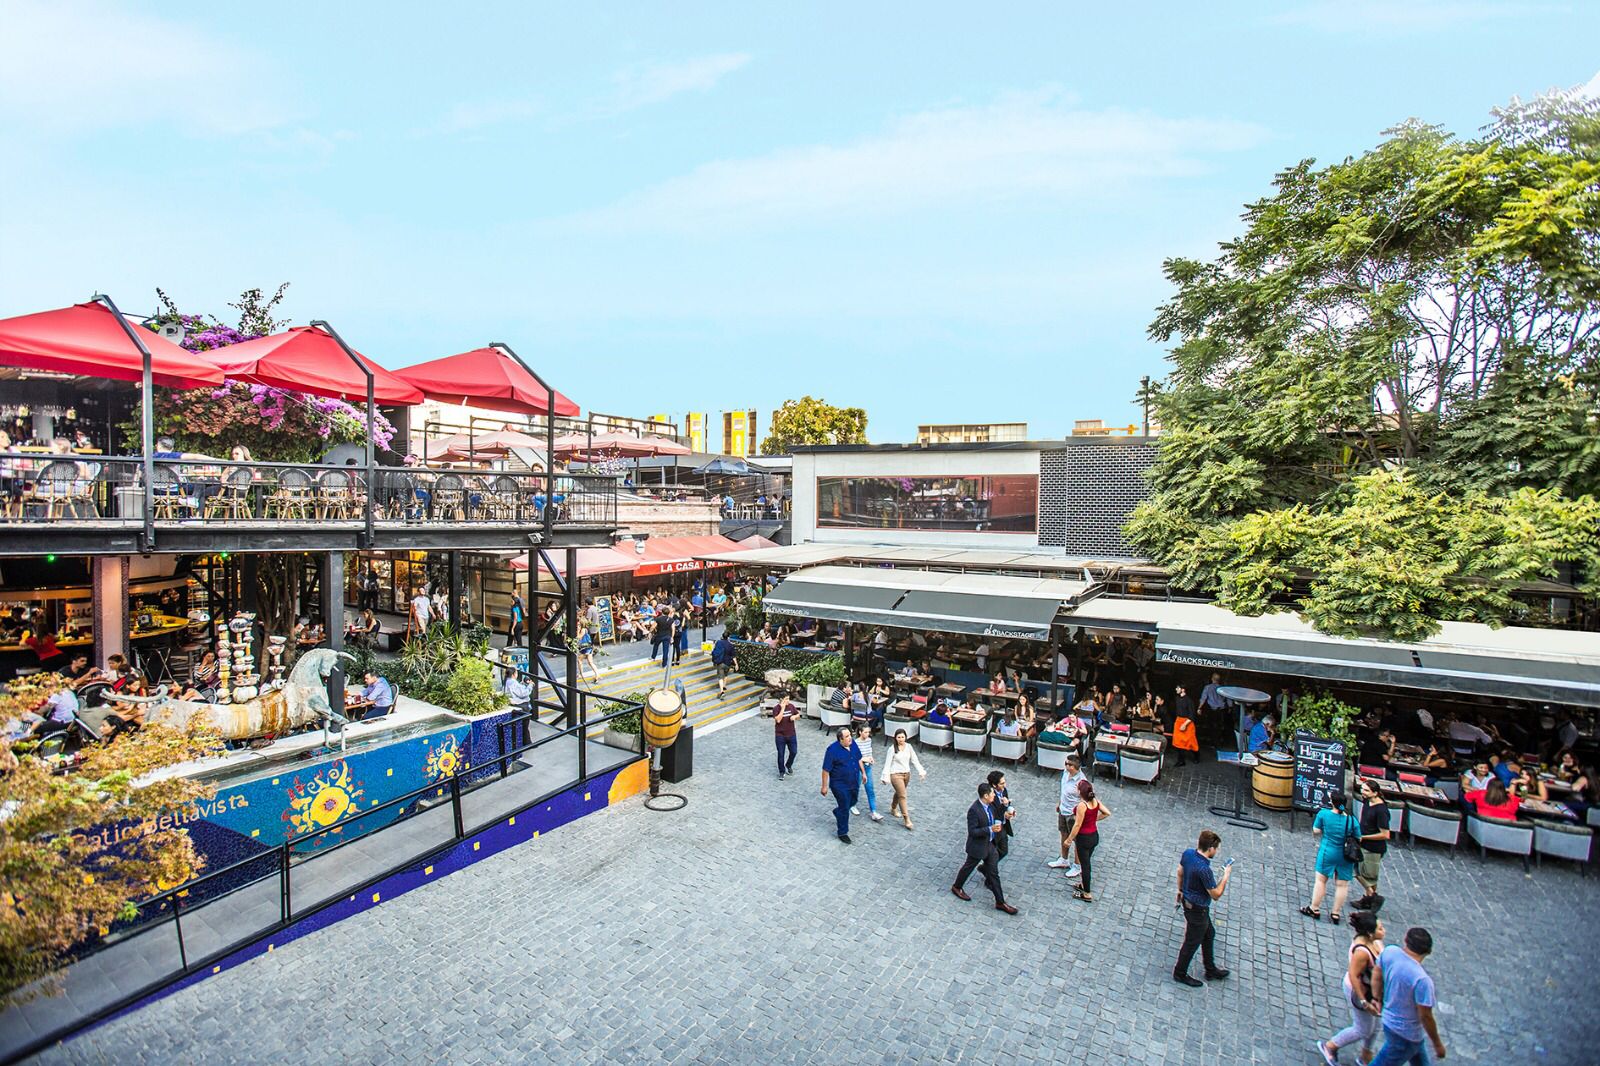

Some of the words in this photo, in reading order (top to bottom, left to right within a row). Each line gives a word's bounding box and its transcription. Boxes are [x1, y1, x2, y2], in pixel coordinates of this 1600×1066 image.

[660, 563, 673, 573] LA
[675, 562, 700, 571] CASA
[142, 794, 249, 836] Bellavista
